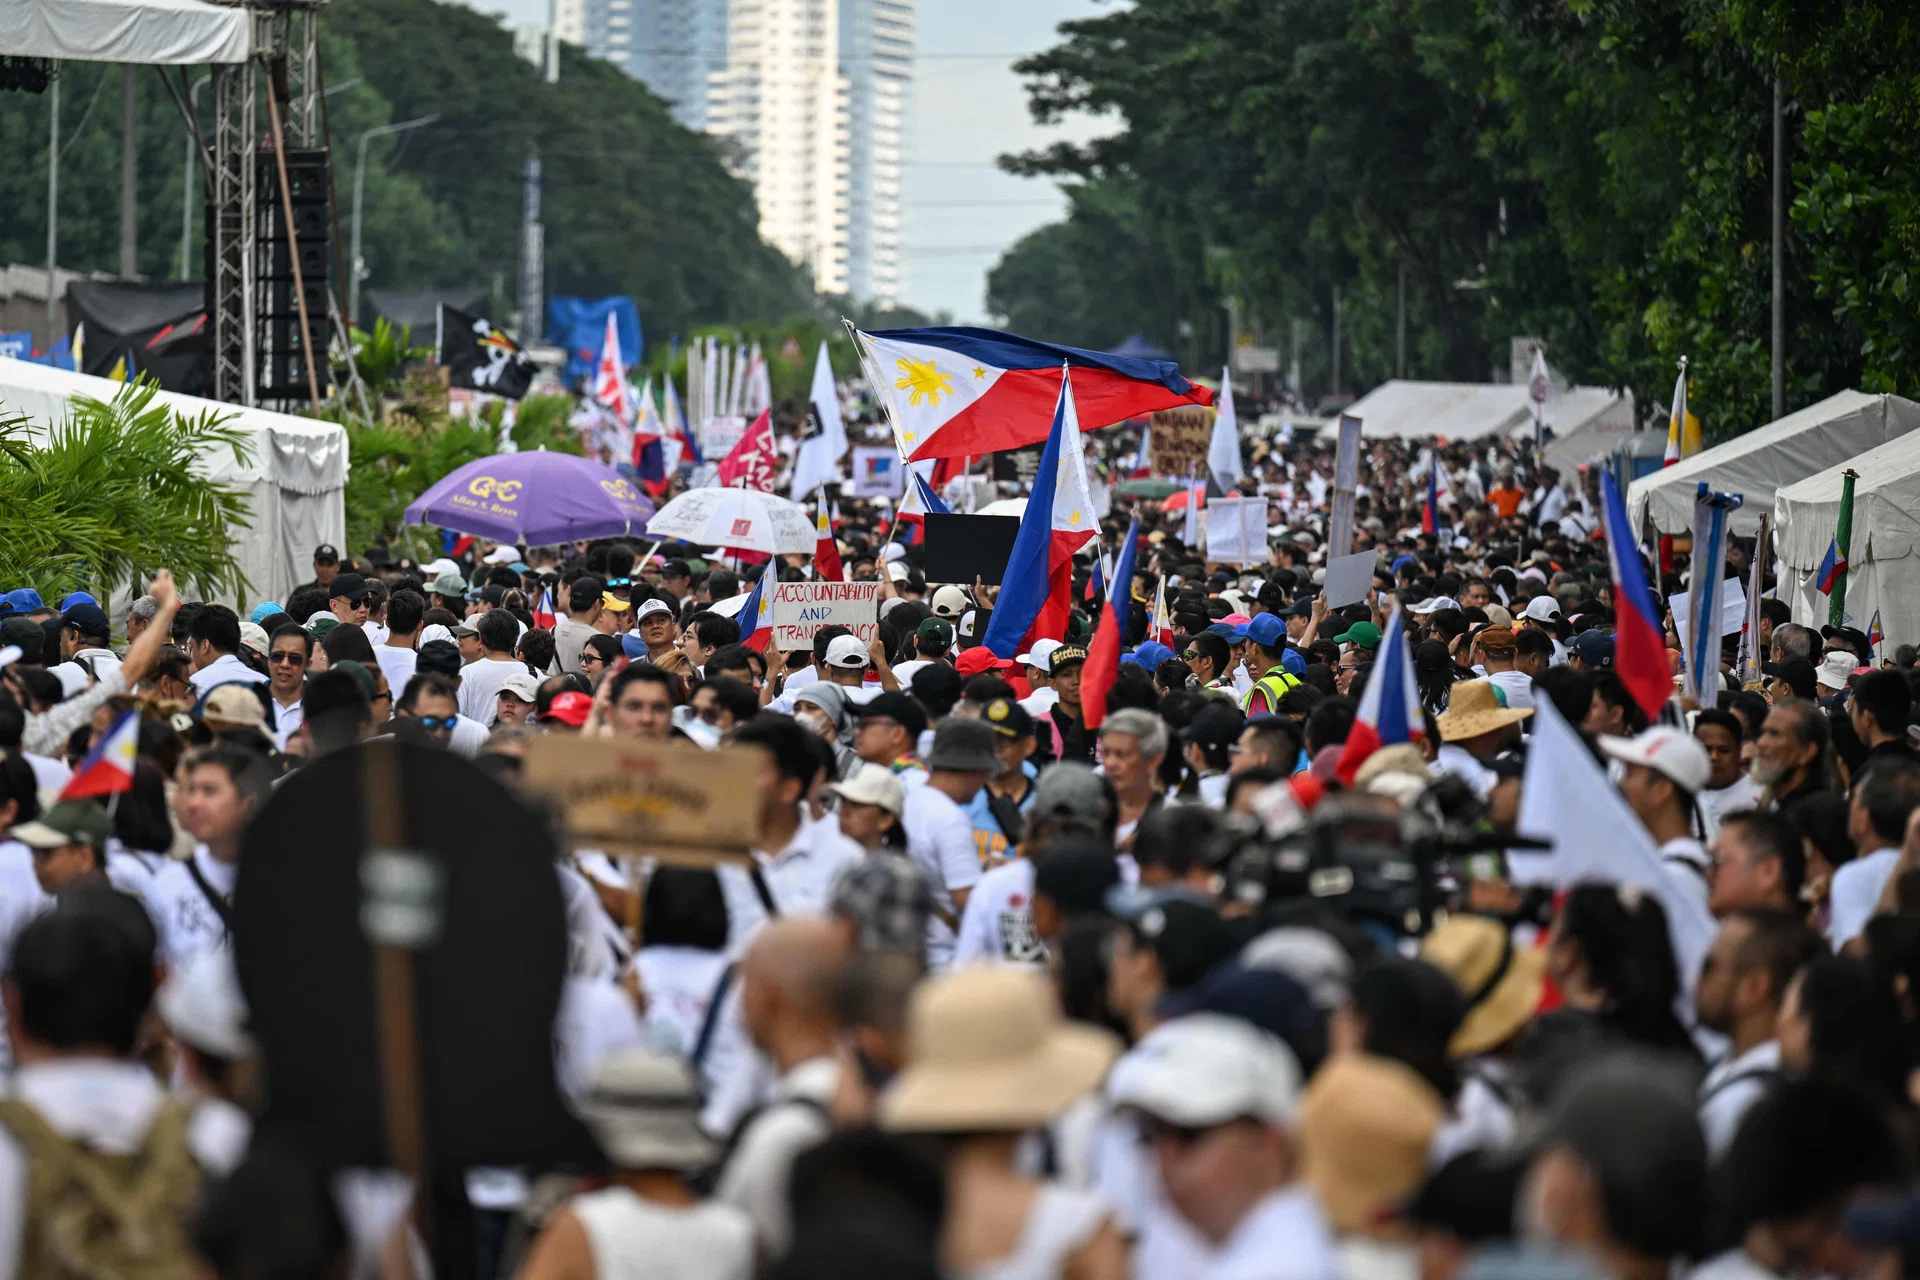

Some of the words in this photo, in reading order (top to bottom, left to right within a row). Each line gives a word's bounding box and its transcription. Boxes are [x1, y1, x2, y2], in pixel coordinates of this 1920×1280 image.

[773, 583, 878, 604] ACCOUNTABILITY
[799, 607, 832, 621] AND
[1052, 646, 1087, 665] Steelers
